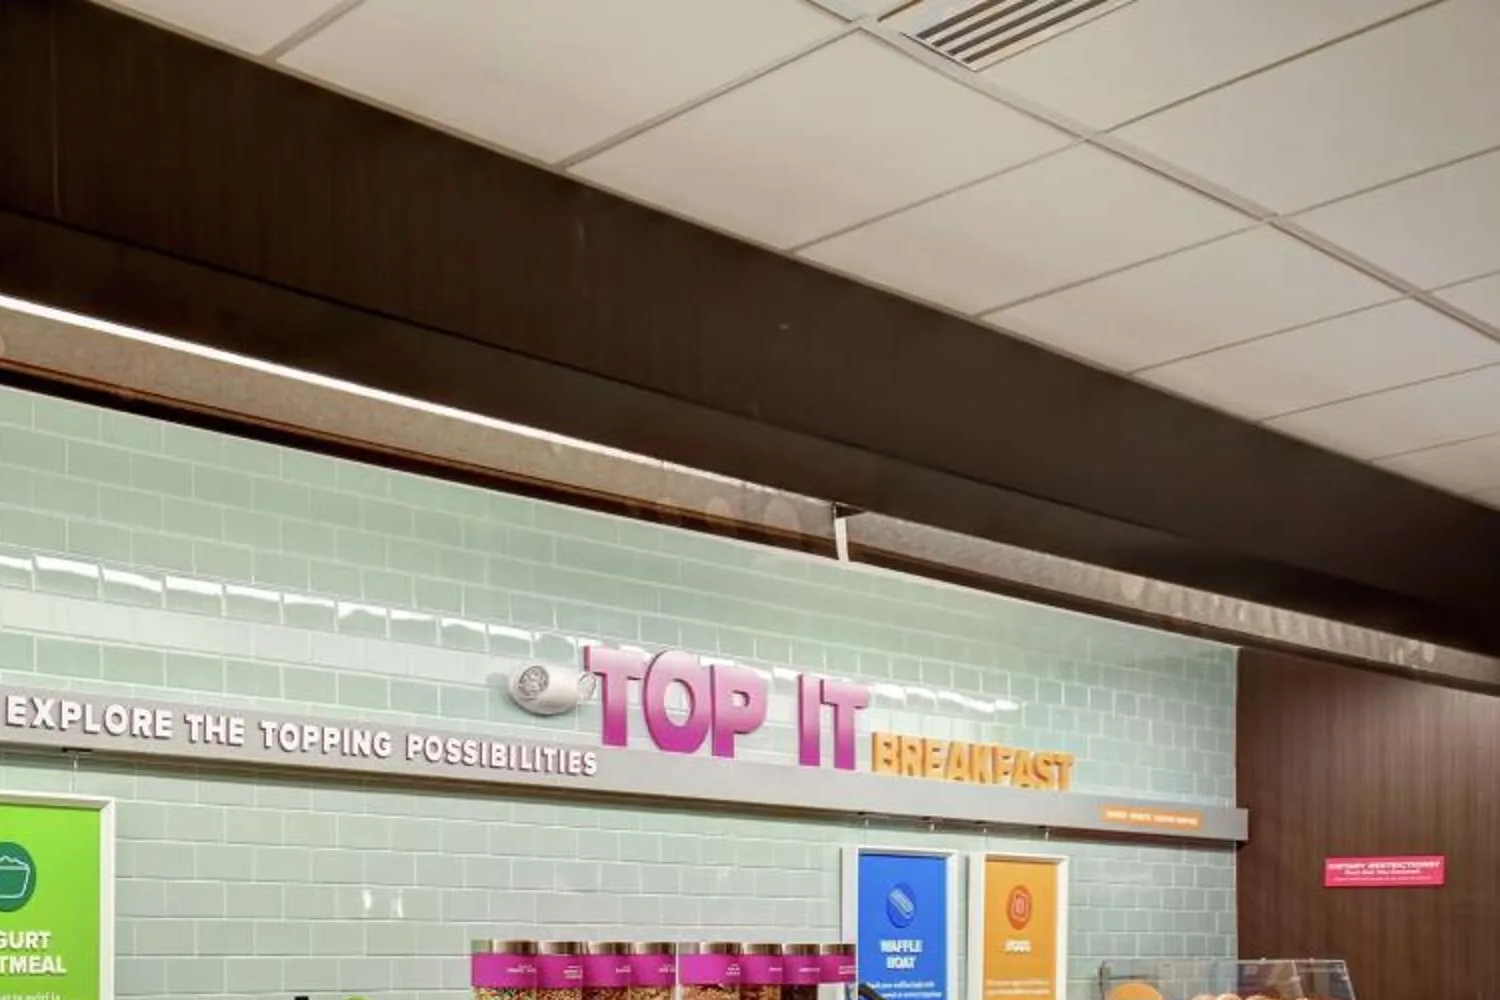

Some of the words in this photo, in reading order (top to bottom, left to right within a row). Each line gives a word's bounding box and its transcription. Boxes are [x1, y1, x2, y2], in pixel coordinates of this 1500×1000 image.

[5, 695, 173, 739] EXPLORE
[184, 713, 244, 747] THE
[260, 719, 392, 758] TOPPING
[406, 733, 598, 776] POSSIBILITIES
[583, 645, 768, 758] TOP
[796, 674, 869, 770] IT
[871, 731, 1074, 791] BREAKFAST
[880, 939, 924, 953] WAFFLE
